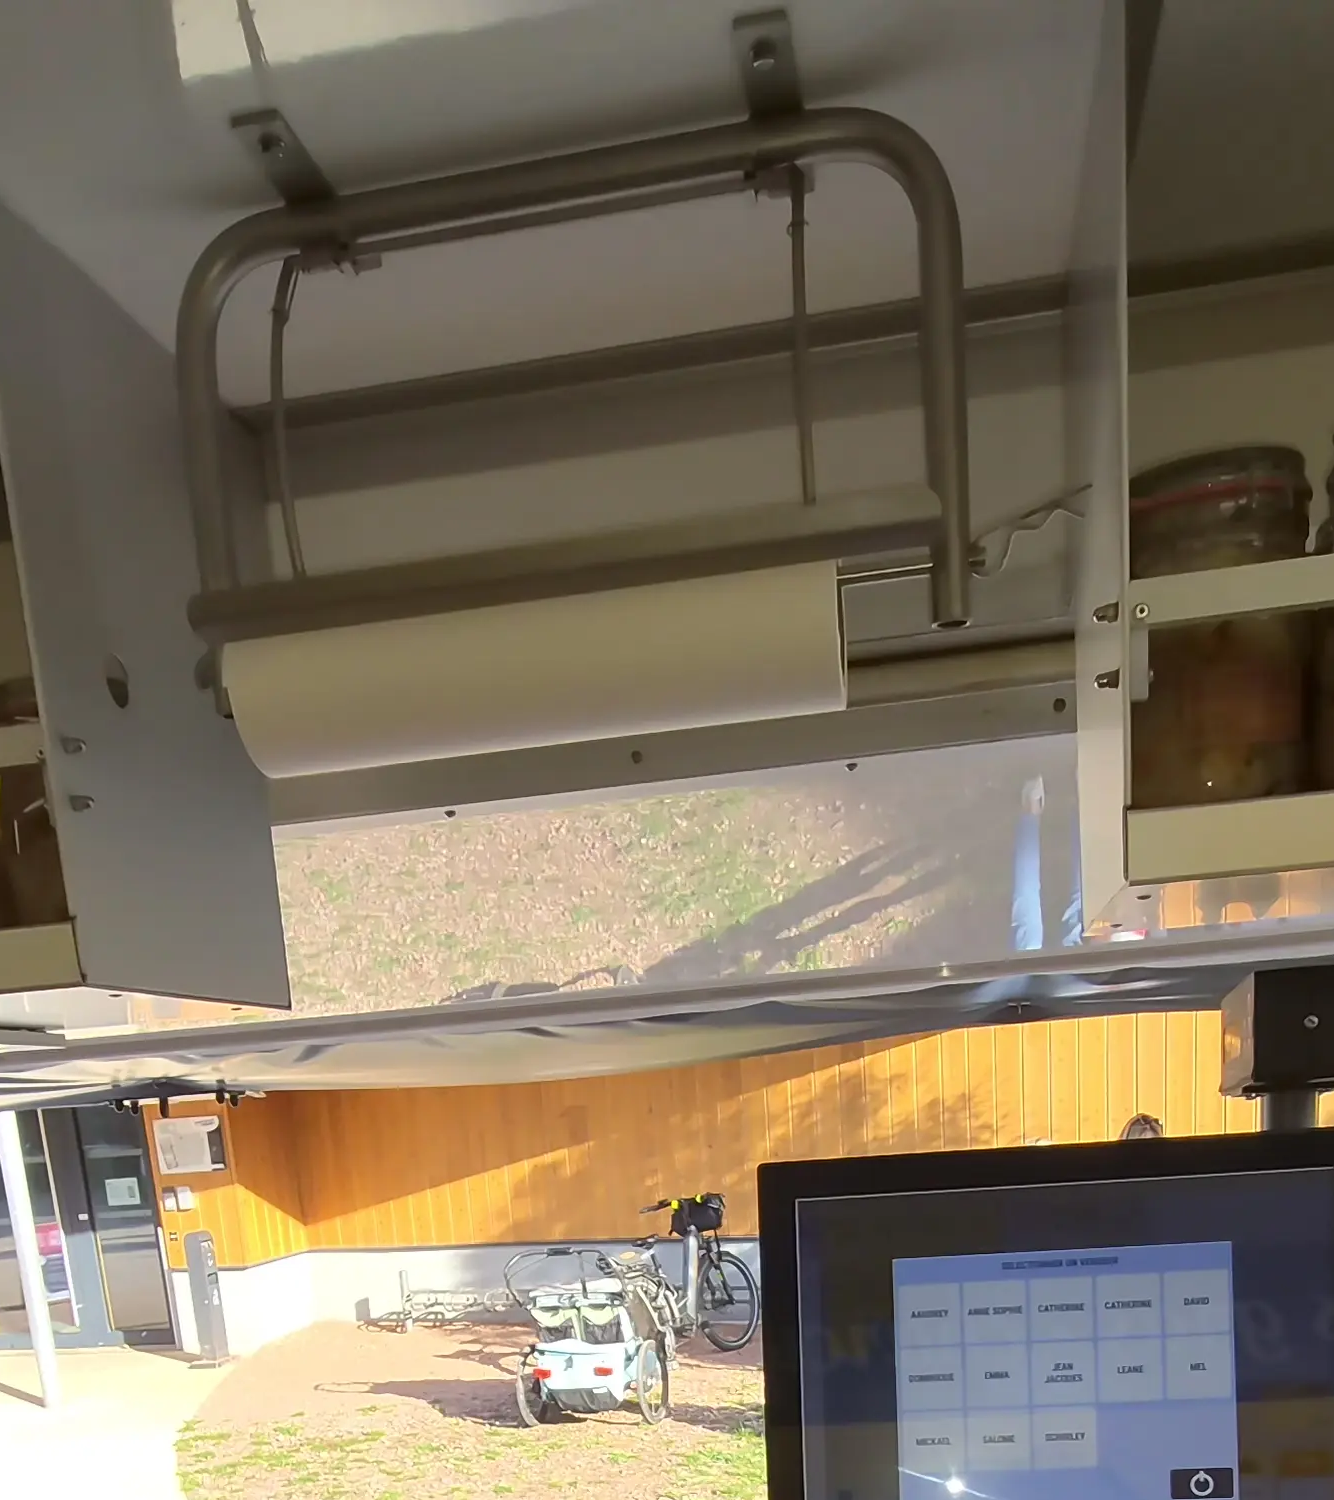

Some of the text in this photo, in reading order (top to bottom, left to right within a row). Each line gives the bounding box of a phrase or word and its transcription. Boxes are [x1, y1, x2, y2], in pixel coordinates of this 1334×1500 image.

[1104, 1299, 1152, 1310] CATHERINE
[1183, 1296, 1210, 1306] DAVID
[1037, 1302, 1085, 1313] CATHERINE
[1052, 1362, 1074, 1372] JEAN
[1189, 1362, 1207, 1371] MEL
[1044, 1373, 1083, 1383] JACQUES
